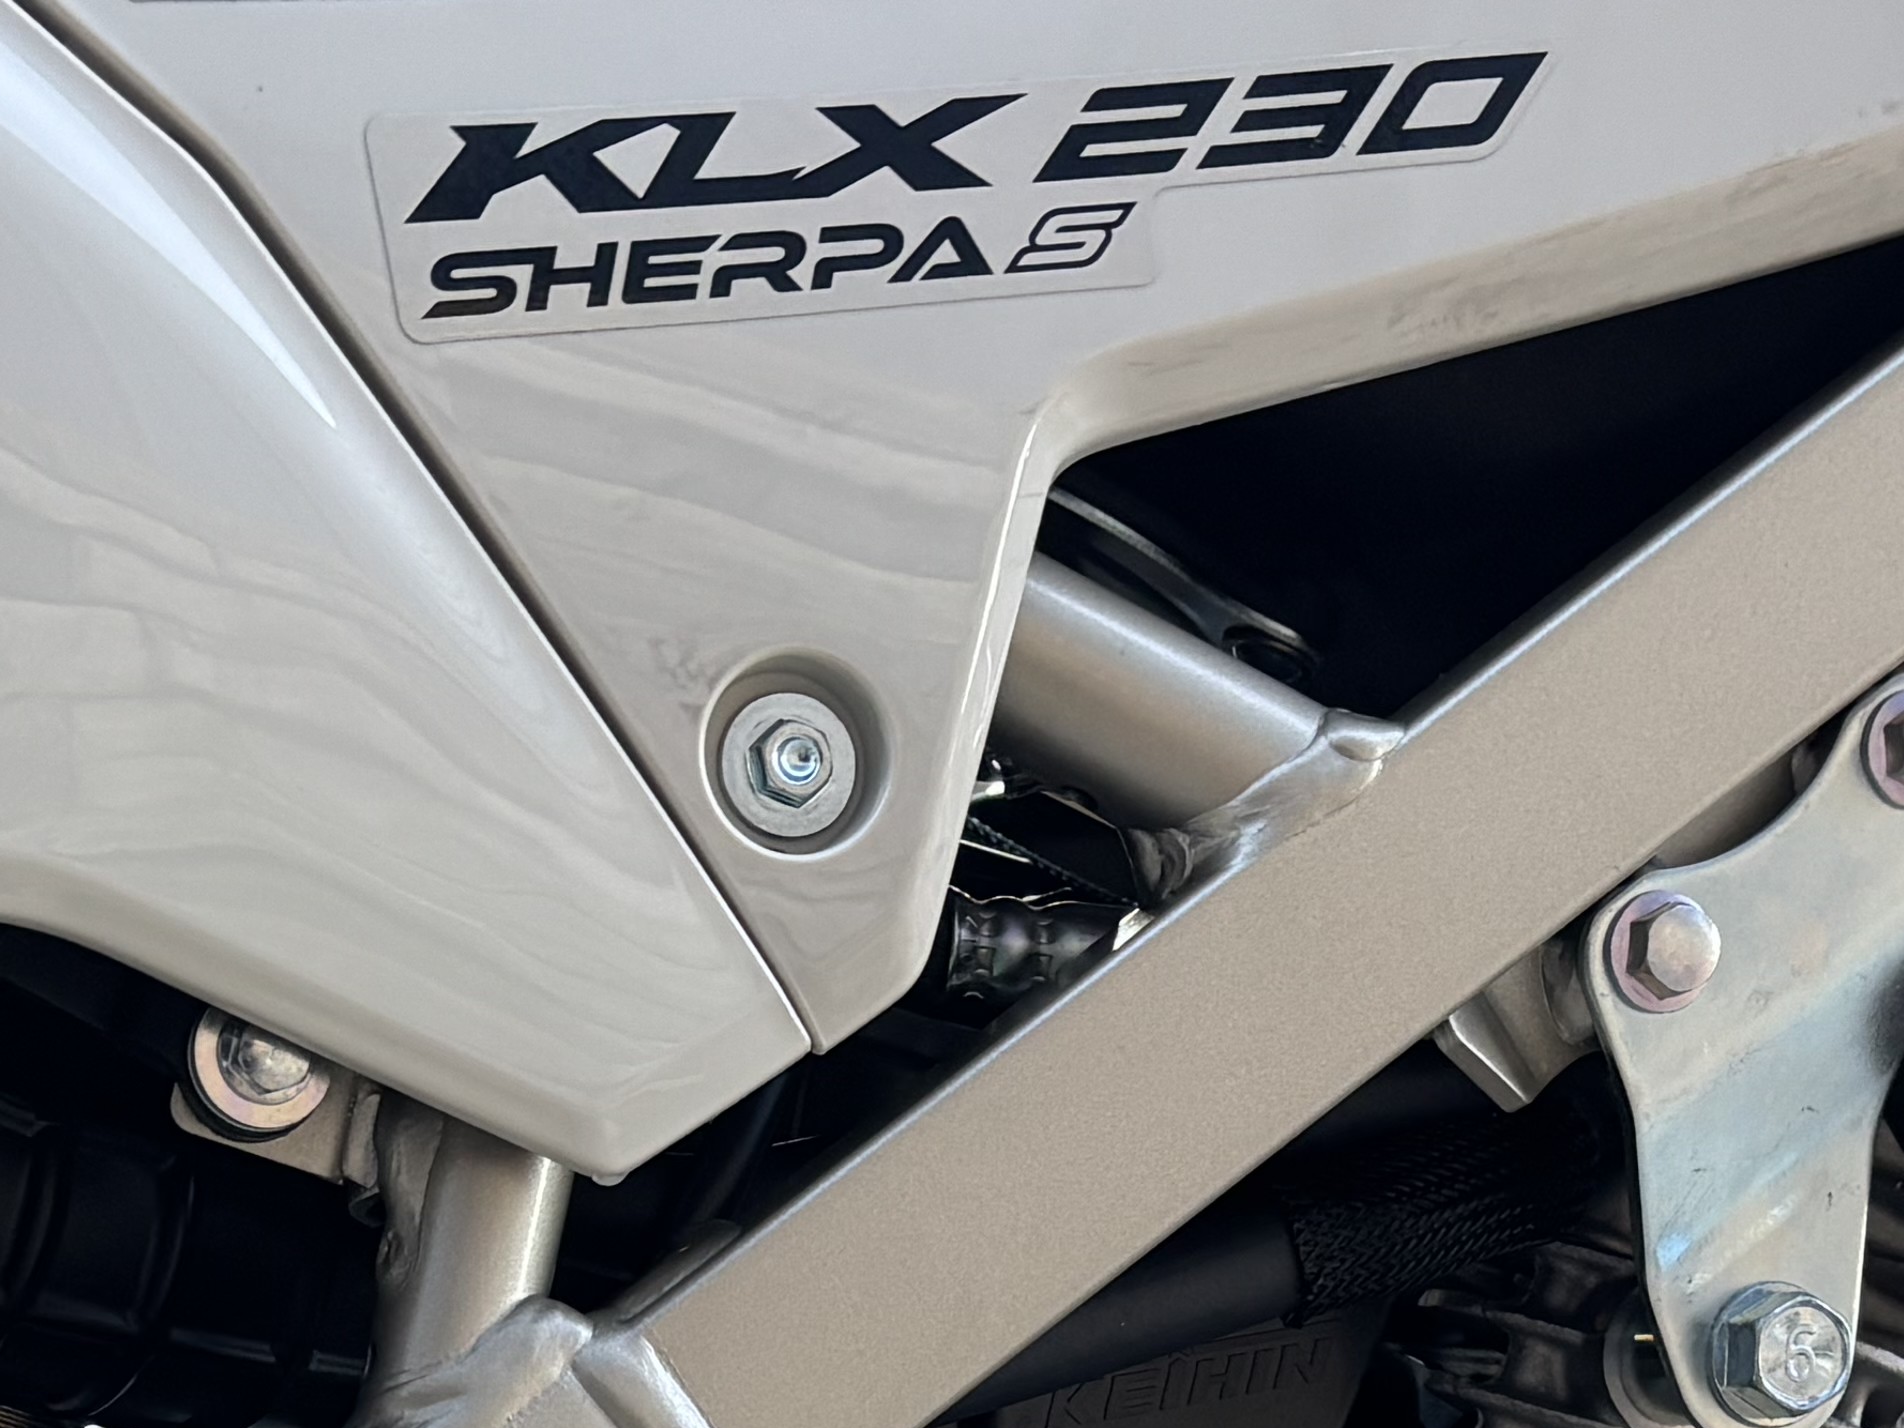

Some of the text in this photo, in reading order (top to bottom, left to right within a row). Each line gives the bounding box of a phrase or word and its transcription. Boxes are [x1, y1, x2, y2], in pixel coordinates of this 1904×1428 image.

[404, 51, 1548, 225] KLX 230
[422, 202, 1137, 320] SHERPA S
